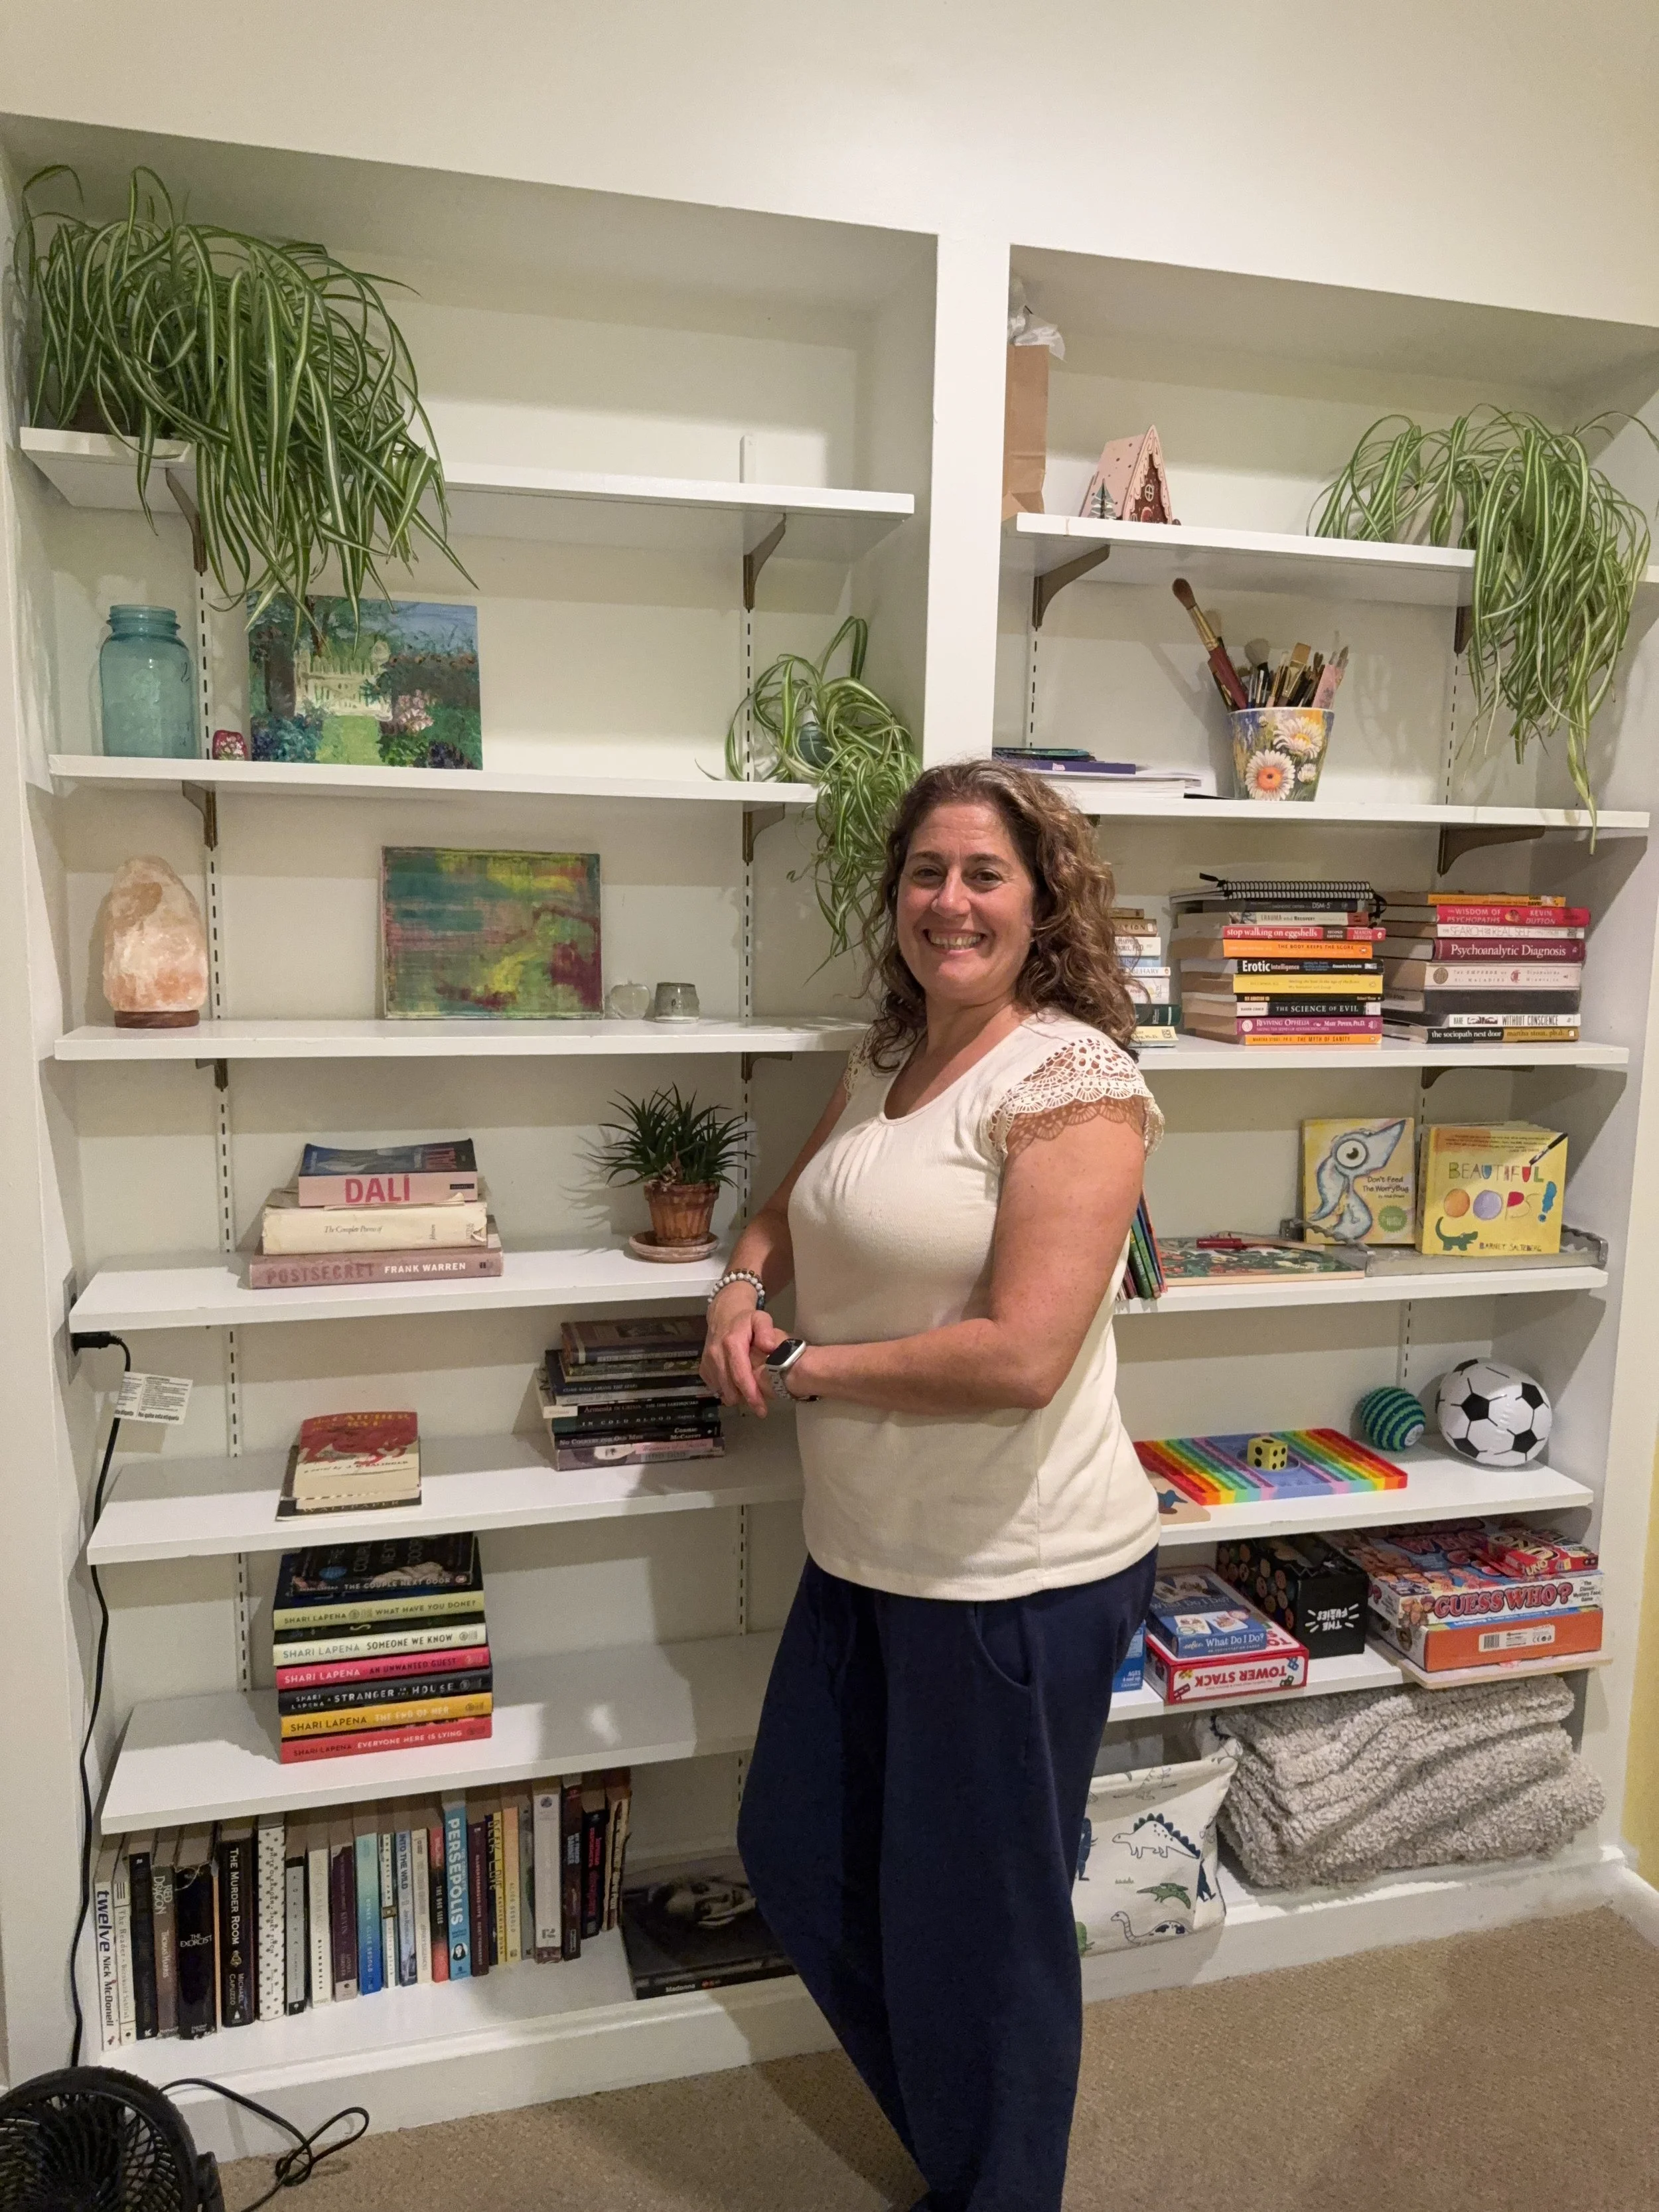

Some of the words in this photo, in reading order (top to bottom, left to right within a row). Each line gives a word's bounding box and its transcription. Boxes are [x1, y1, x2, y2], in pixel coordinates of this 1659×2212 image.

[1227, 928, 1243, 937] stop
[1244, 928, 1273, 938] walking
[1285, 928, 1317, 938] eggshells
[1450, 926, 1482, 936] SEARCH
[1492, 926, 1514, 936] REAL
[1515, 926, 1531, 936] SELF
[1451, 944, 1520, 960] Psychoanalytic
[1522, 945, 1567, 960] Diagnosis
[1242, 960, 1271, 972] Erotic
[1453, 1017, 1464, 1025] HARE
[1502, 1015, 1526, 1026] WITHOUT
[1527, 1015, 1559, 1026] CONSCIENCE
[1443, 1030, 1473, 1040] sociopath
[1387, 1175, 1404, 1183] Feed
[1448, 1161, 1545, 1183] BEAUTIFUL
[1375, 1184, 1409, 1193] WorryBug
[324, 1225, 336, 1234] The
[337, 1226, 360, 1234] Complete
[360, 1225, 376, 1234] Poems
[376, 1225, 384, 1234] of
[1479, 1241, 1506, 1250] BARNEY
[267, 1262, 375, 1285] POSTSECRET
[384, 1264, 419, 1274] FRANK
[421, 1261, 467, 1272] WARREN
[1525, 1560, 1548, 1576] UNO
[363, 1580, 399, 1590] COUPLE
[1433, 1589, 1505, 1619] GUESS
[1506, 1582, 1573, 1609] WHO?
[284, 1615, 310, 1625] SHARI
[312, 1612, 347, 1622] LAPENA
[375, 1607, 400, 1616] WHAT
[401, 1605, 425, 1614] HAVE
[427, 1602, 445, 1611] YOU
[447, 1600, 476, 1609] DONE?
[1322, 1620, 1342, 1631] THE
[282, 1648, 315, 1659] SHARI
[318, 1643, 361, 1656] LAPENA
[366, 1640, 409, 1651] SOMEONE
[411, 1638, 425, 1647] WE
[427, 1634, 453, 1644] KNOW
[1205, 1637, 1229, 1648] What
[1230, 1636, 1242, 1645] Do
[1243, 1635, 1248, 1644] I
[1248, 1633, 1265, 1643] Do?
[285, 1674, 317, 1684] SHARI
[319, 1669, 361, 1680] LAPENA
[383, 1660, 429, 1673] UNWANTED
[431, 1657, 457, 1667] GUEST
[1194, 1672, 1236, 1687] STACK
[1239, 1666, 1287, 1682] TOWER
[295, 1694, 322, 1703] SHARI
[333, 1689, 396, 1704] STRANGER
[411, 1683, 455, 1695] HOUSE
[291, 1701, 325, 1710] LAPENA
[290, 1721, 323, 1732] SHARI
[325, 1716, 368, 1729] LAPENA
[374, 1713, 392, 1722] THE
[396, 1710, 413, 1720] END
[416, 1708, 428, 1718] OF
[431, 1706, 450, 1716] HER
[293, 1748, 319, 1757] SHARI
[320, 1743, 353, 1754] LAPENA
[357, 1737, 402, 1749] EVERYONE
[403, 1734, 425, 1744] HERE
[427, 1733, 437, 1741] IS
[438, 1730, 463, 1740] LYING
[487, 1819, 502, 1854] GEEK
[229, 1848, 240, 1870] THE
[448, 1818, 464, 1926] PERSEPOLIS
[488, 1858, 503, 1891] LOVE
[153, 1876, 167, 1915] DRAGON
[163, 1883, 173, 1903] RED
[230, 1872, 240, 1913] MURDER
[97, 1889, 113, 1953] twelve
[231, 1915, 241, 1945] ROOM
[119, 1929, 127, 1957] Reader
[161, 1929, 169, 1954] THOMAS
[180, 1935, 213, 1948] EXORCIST
[162, 1954, 171, 1978] HARRIS
[666, 1984, 695, 1992] Madonna
[104, 1980, 114, 2027] McDonell
